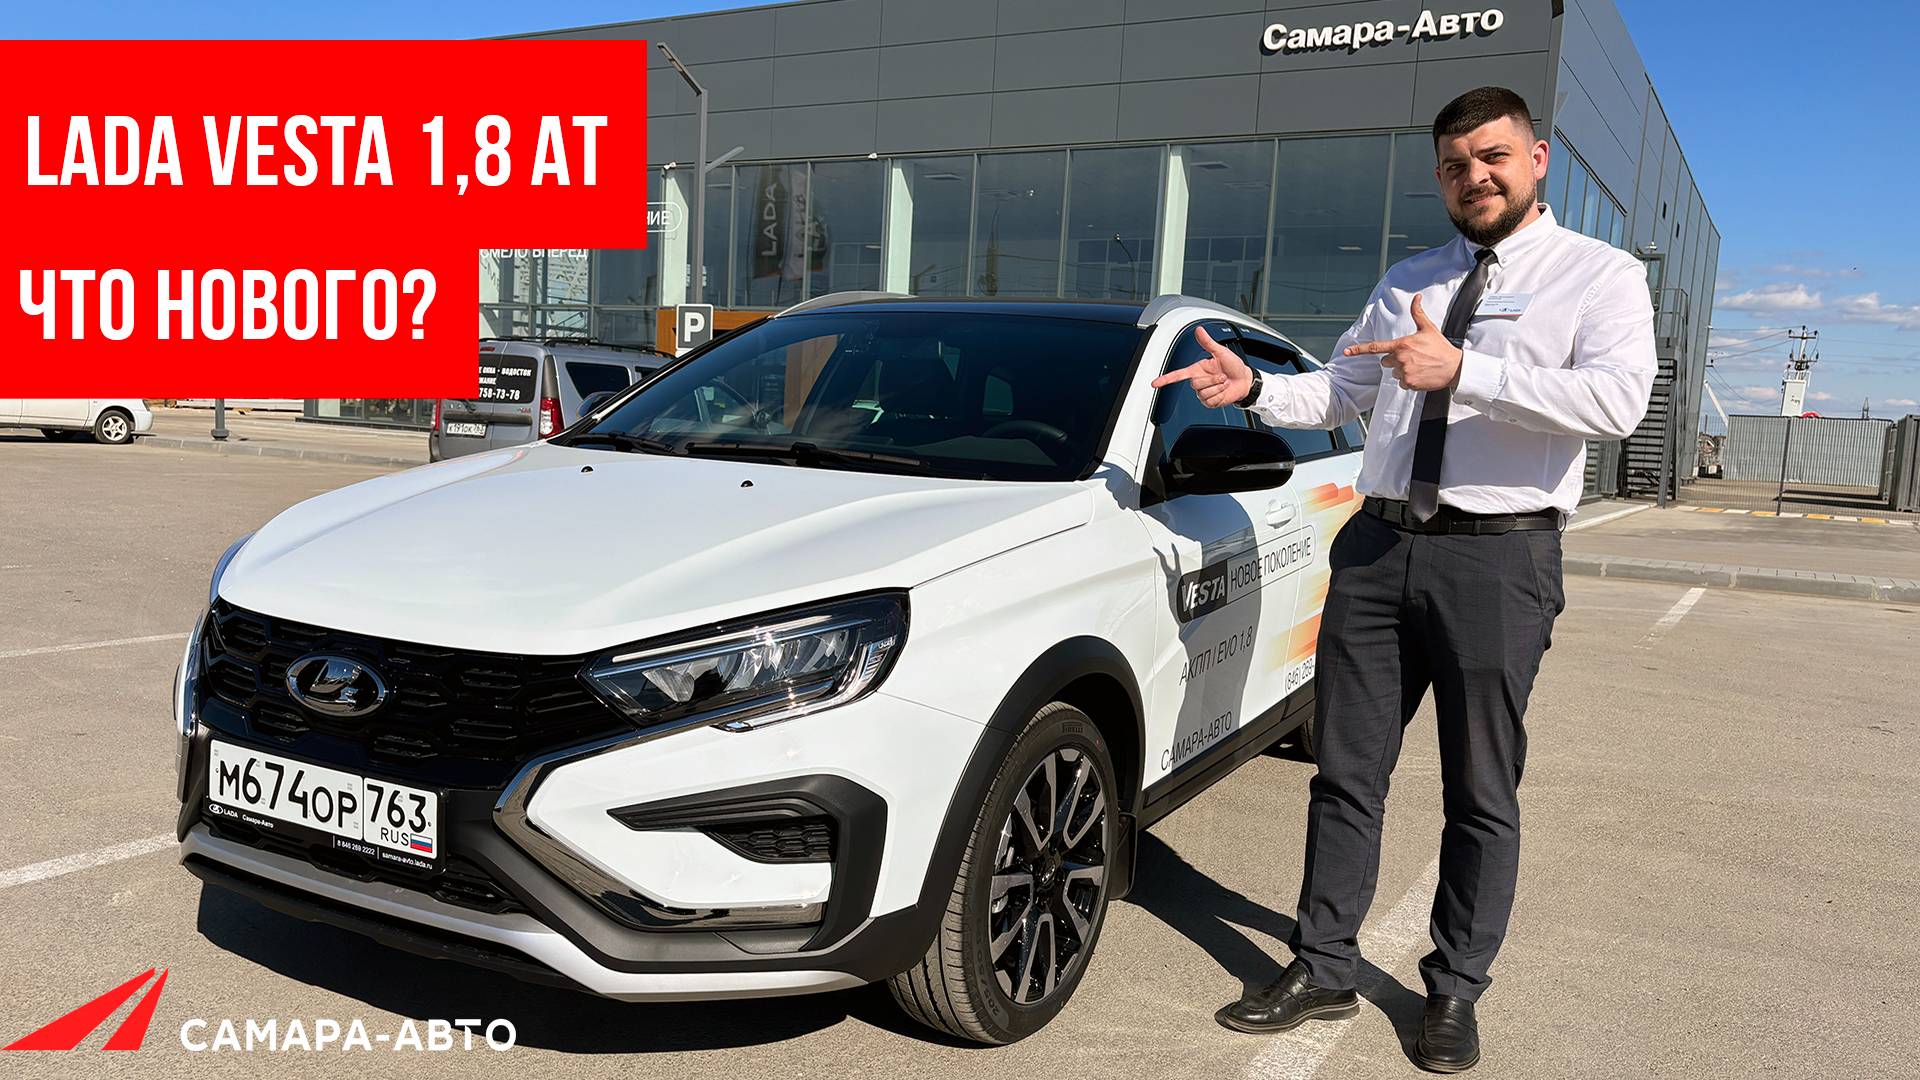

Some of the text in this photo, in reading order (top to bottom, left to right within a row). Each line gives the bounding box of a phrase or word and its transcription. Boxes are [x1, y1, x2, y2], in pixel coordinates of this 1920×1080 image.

[1262, 9, 1504, 50] Самара-Авто
[761, 183, 778, 257] LADA
[1230, 536, 1311, 593] НОВОЕ ПОКОЛЕНИЕ
[1181, 574, 1226, 612] VESTA
[1179, 648, 1211, 686] АКПП
[1217, 634, 1238, 664] EVO
[1240, 625, 1253, 653] 1,8
[1160, 711, 1232, 771] САМАРА-АВТО
[223, 808, 238, 818] LADA
[366, 783, 428, 833] 763
[362, 846, 375, 856] 2222
[380, 827, 409, 846] RUS
